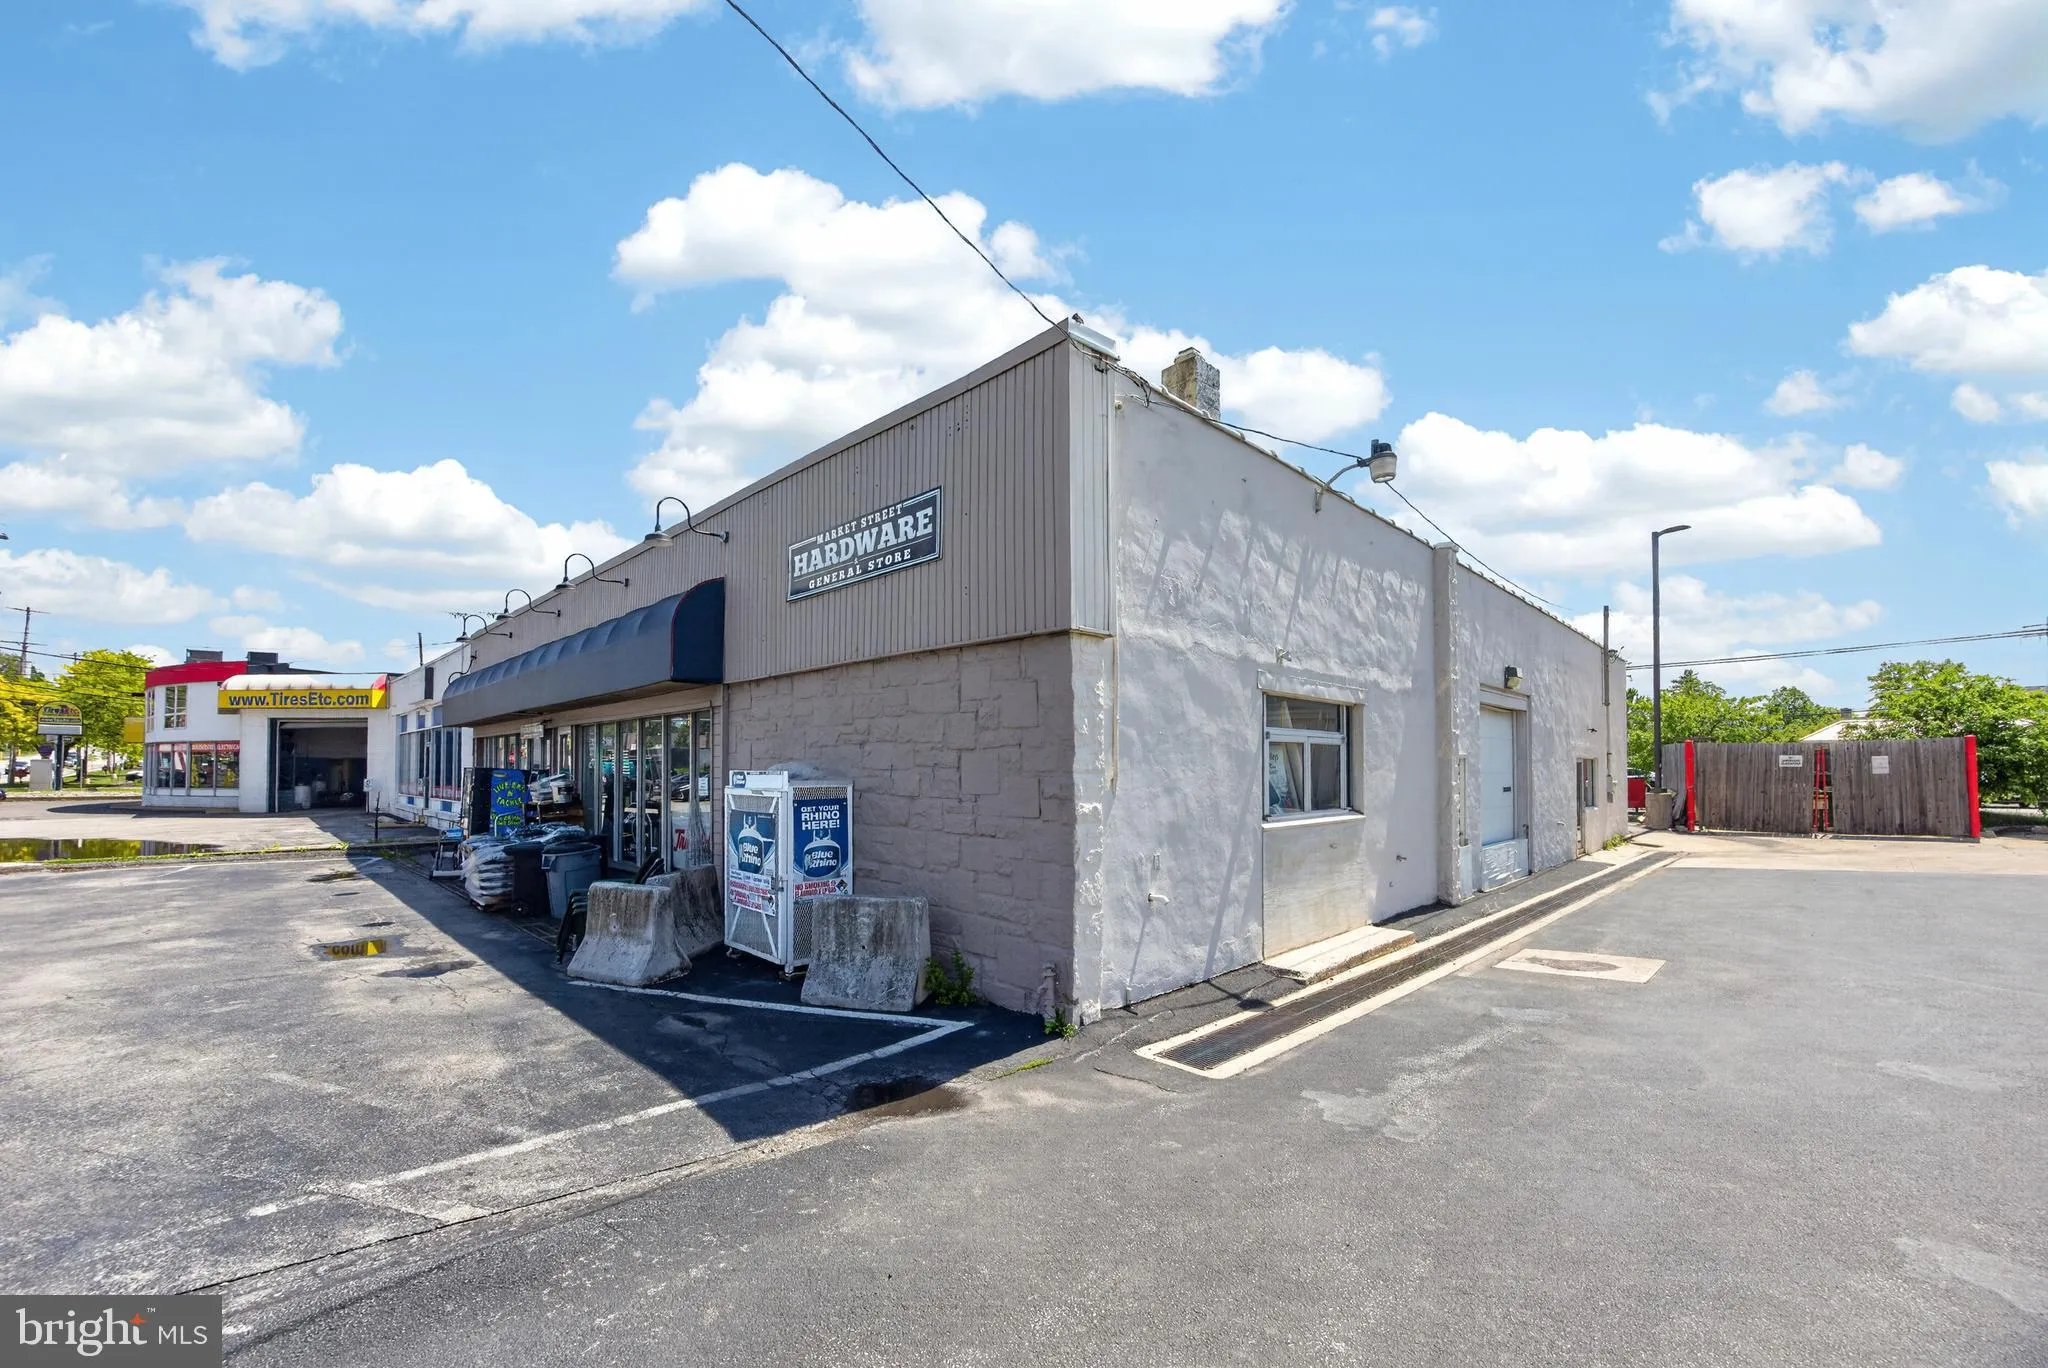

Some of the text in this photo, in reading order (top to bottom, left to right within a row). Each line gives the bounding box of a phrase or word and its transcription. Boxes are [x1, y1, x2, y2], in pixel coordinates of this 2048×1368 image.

[816, 504, 903, 545] MARKET STREET
[793, 506, 934, 578] HARDWARE
[808, 548, 912, 590] GENERAL STORE
[228, 691, 369, 707] www.TiresEtc.com
[801, 810, 840, 821] RHINO
[801, 819, 840, 831] HERE!
[743, 842, 759, 854] Blue
[811, 850, 834, 860] Blue
